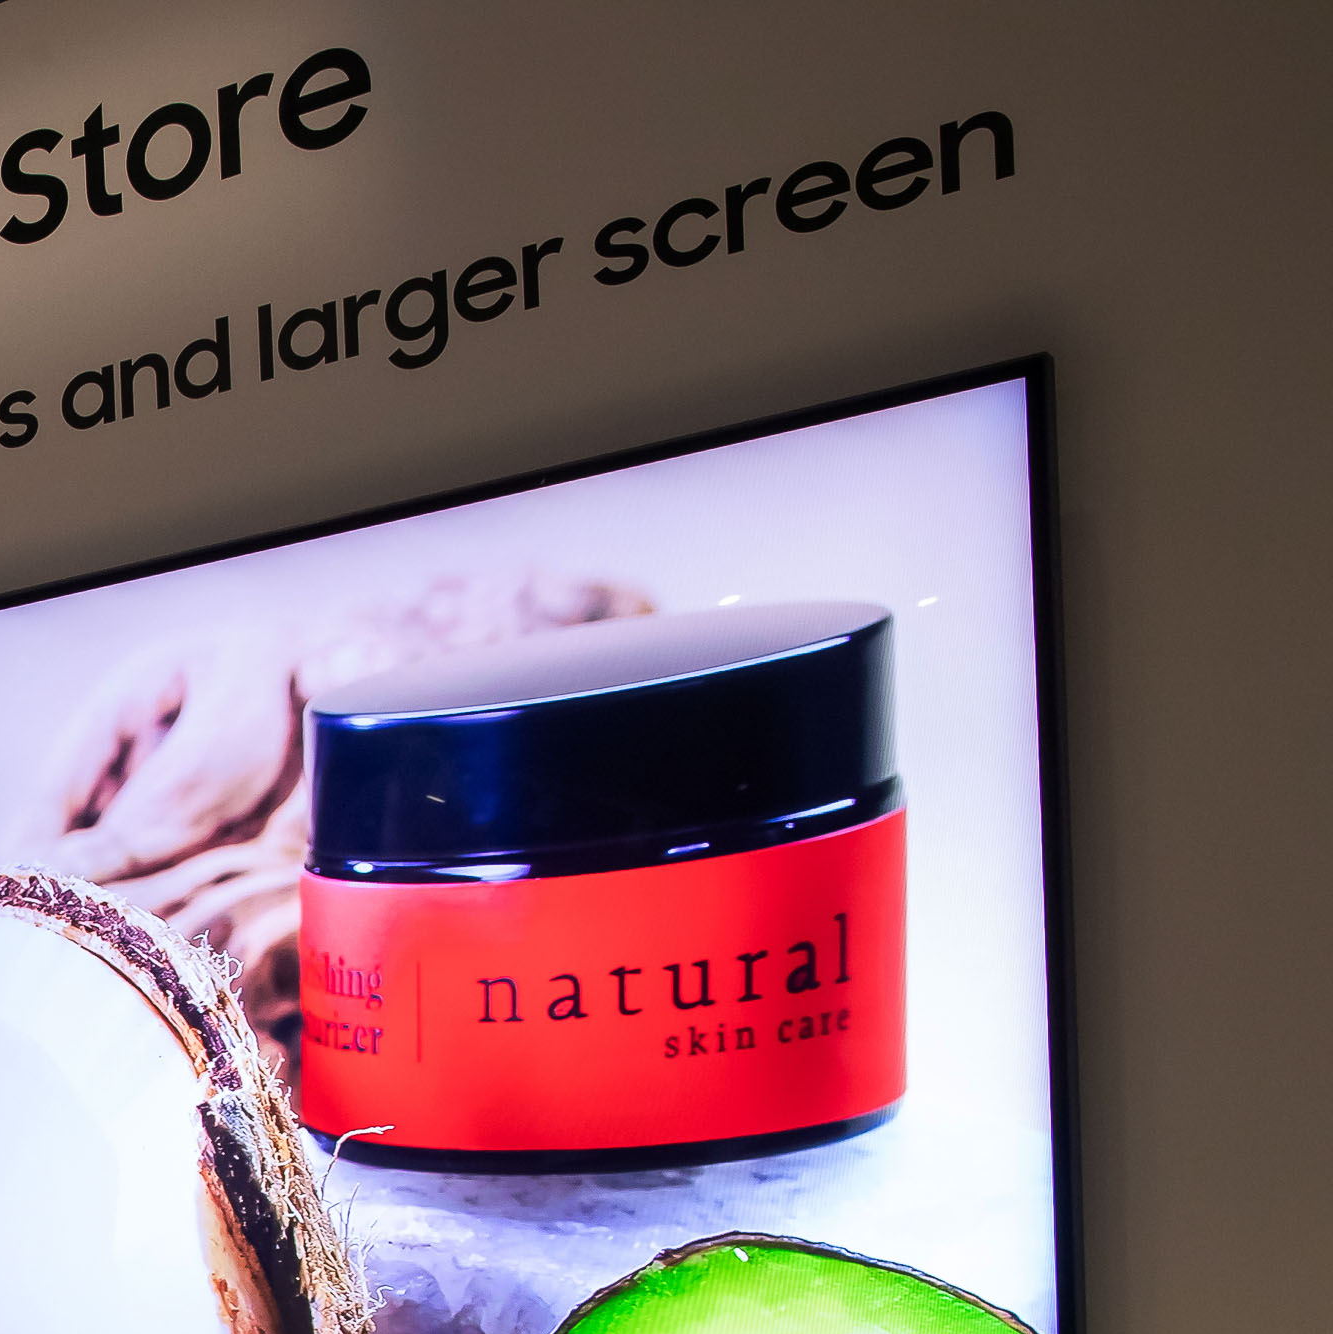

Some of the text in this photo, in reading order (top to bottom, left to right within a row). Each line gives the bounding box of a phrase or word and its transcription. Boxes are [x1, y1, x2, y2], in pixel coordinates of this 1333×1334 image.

[0, 47, 372, 245] Store
[61, 315, 232, 430] and
[257, 237, 564, 382] larger
[593, 110, 1016, 286] screen
[476, 912, 853, 1023] natural
[664, 1006, 851, 1059] skin care
